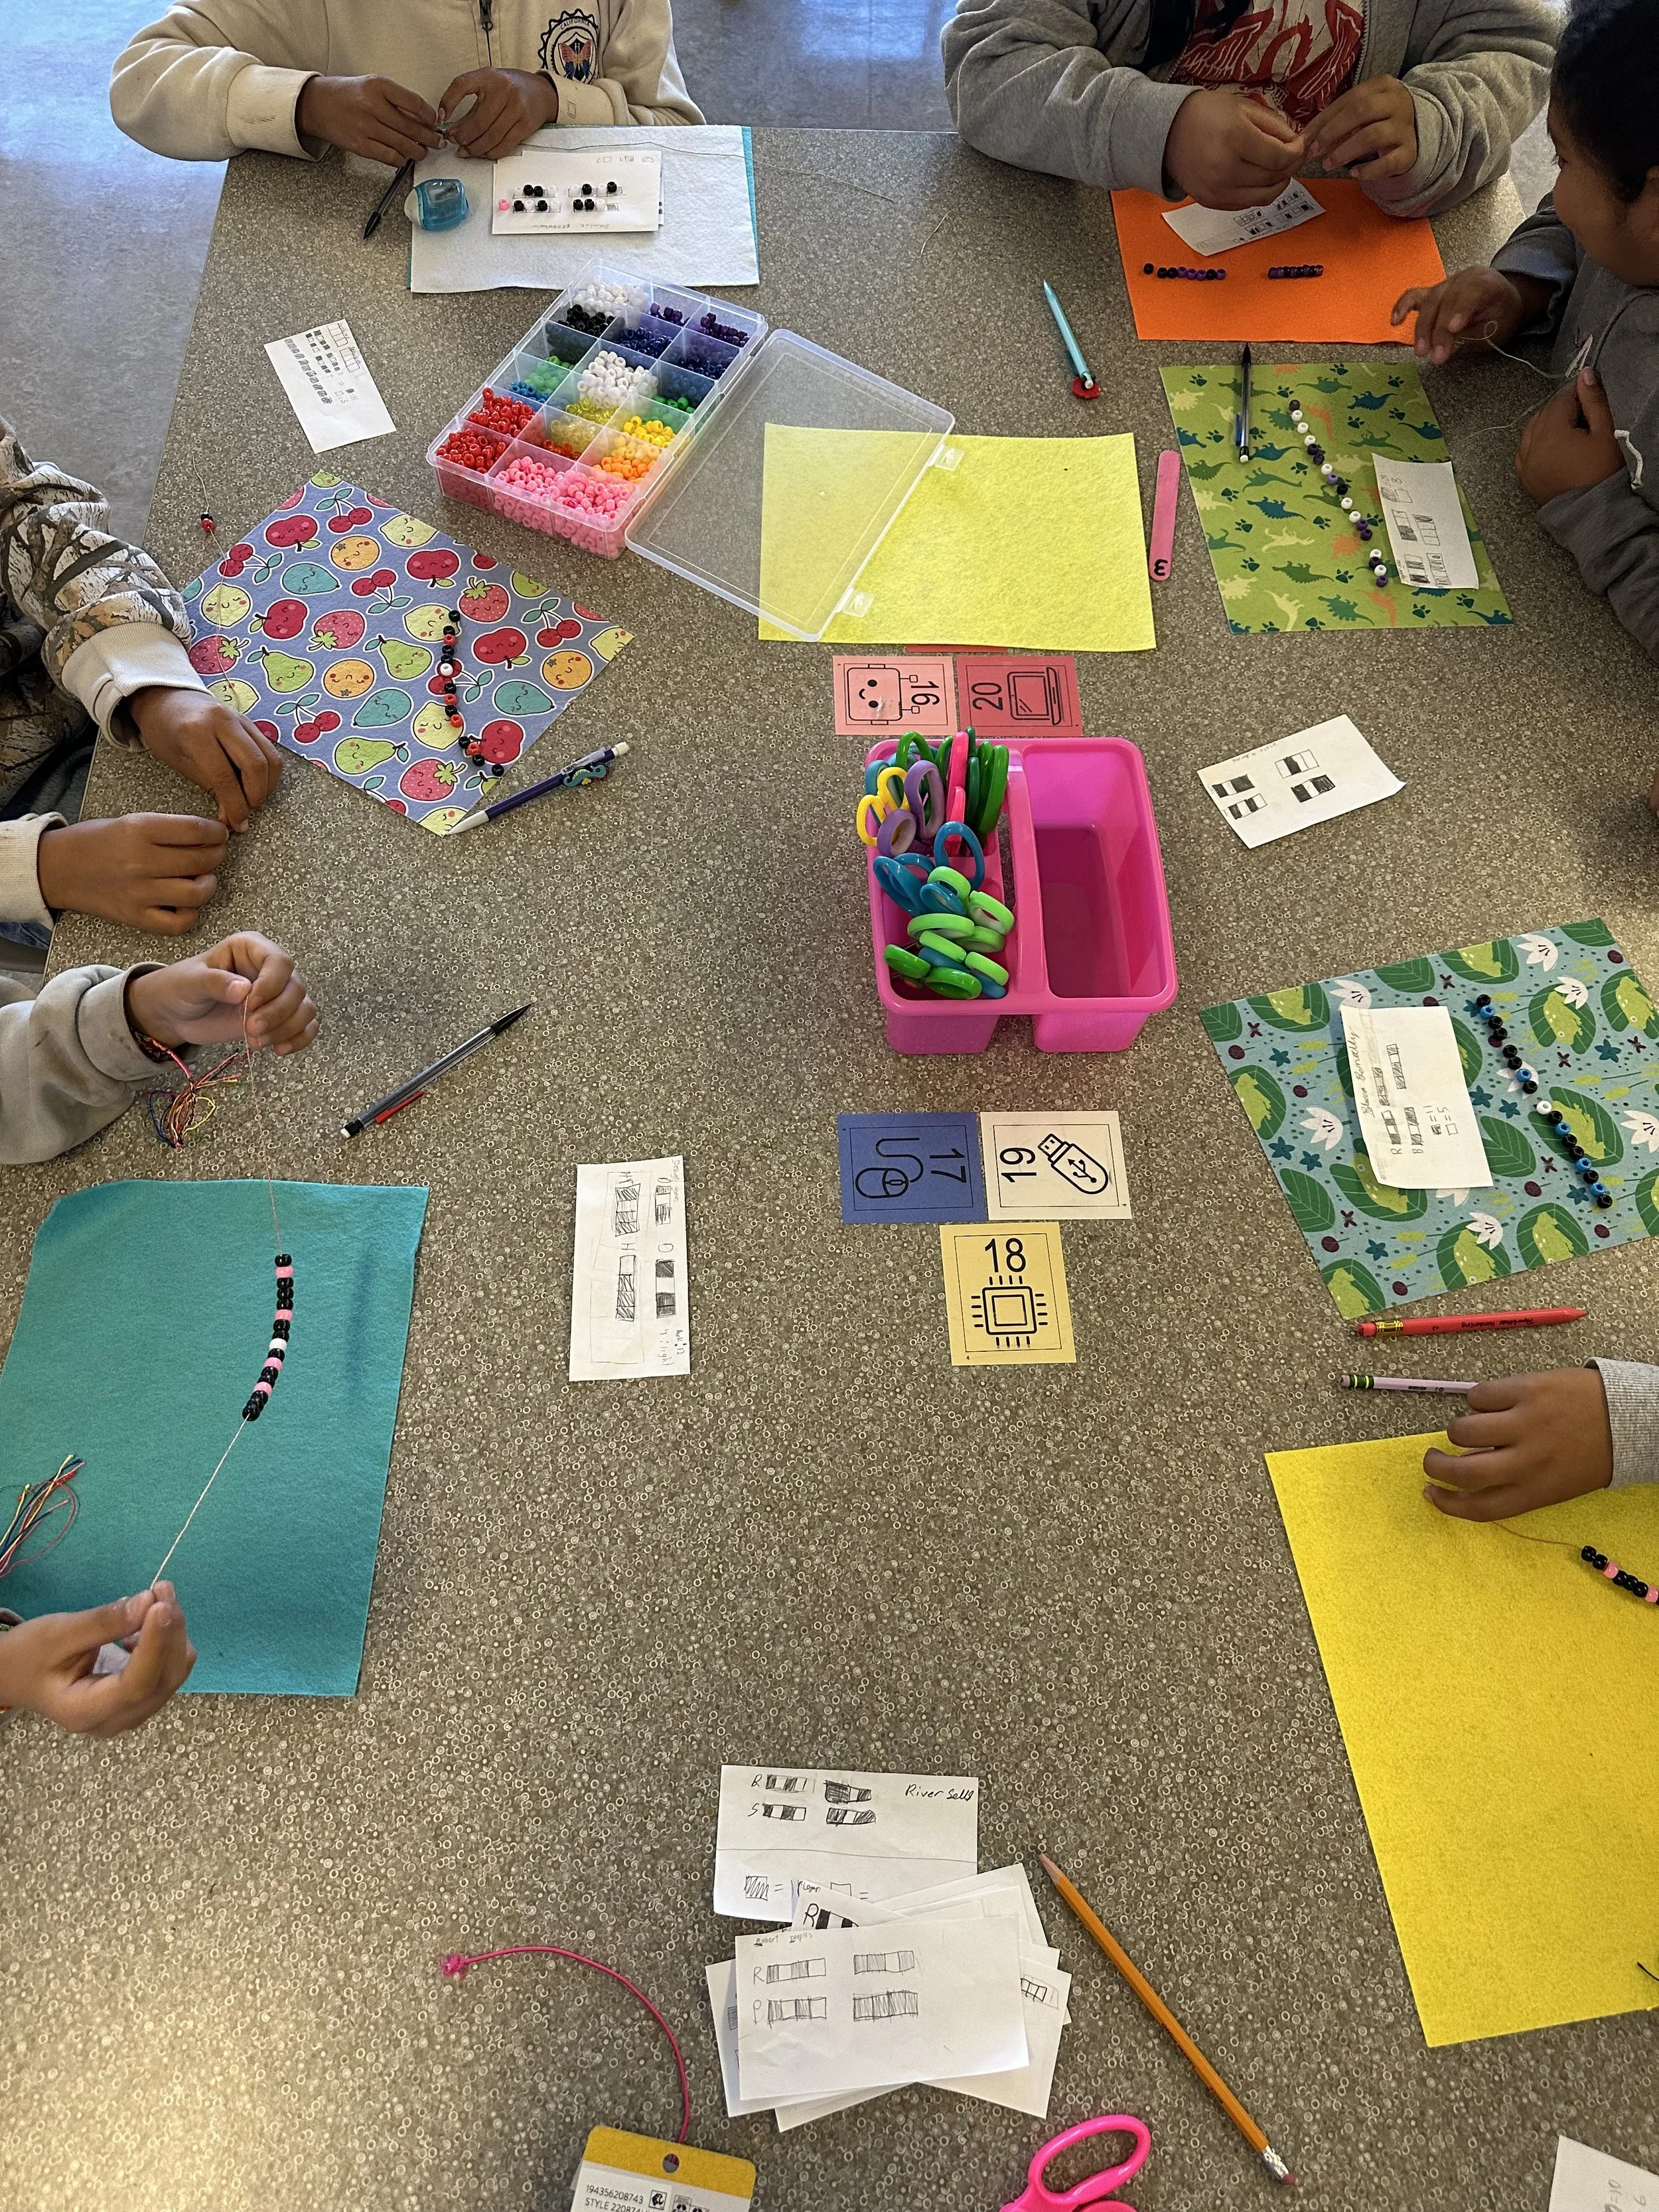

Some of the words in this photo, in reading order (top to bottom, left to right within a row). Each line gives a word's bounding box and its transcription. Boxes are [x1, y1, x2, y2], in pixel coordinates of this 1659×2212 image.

[561, 18, 590, 30] CALIFORNIA
[911, 680, 940, 705] 16
[971, 682, 1003, 711] 20
[929, 1148, 967, 1183] 17
[1000, 1147, 1037, 1183] 19
[985, 1237, 1026, 1273] 18
[1461, 1320, 1495, 1329] Handwriting
[751, 1773, 762, 1788] R
[905, 1784, 944, 1799] River
[748, 1803, 758, 1817] S
[803, 1903, 819, 1927] R
[753, 1965, 765, 1984] R
[753, 1999, 762, 2025] P
[585, 2197, 610, 2210] STYLE
[587, 2184, 644, 2204] 194356208743
